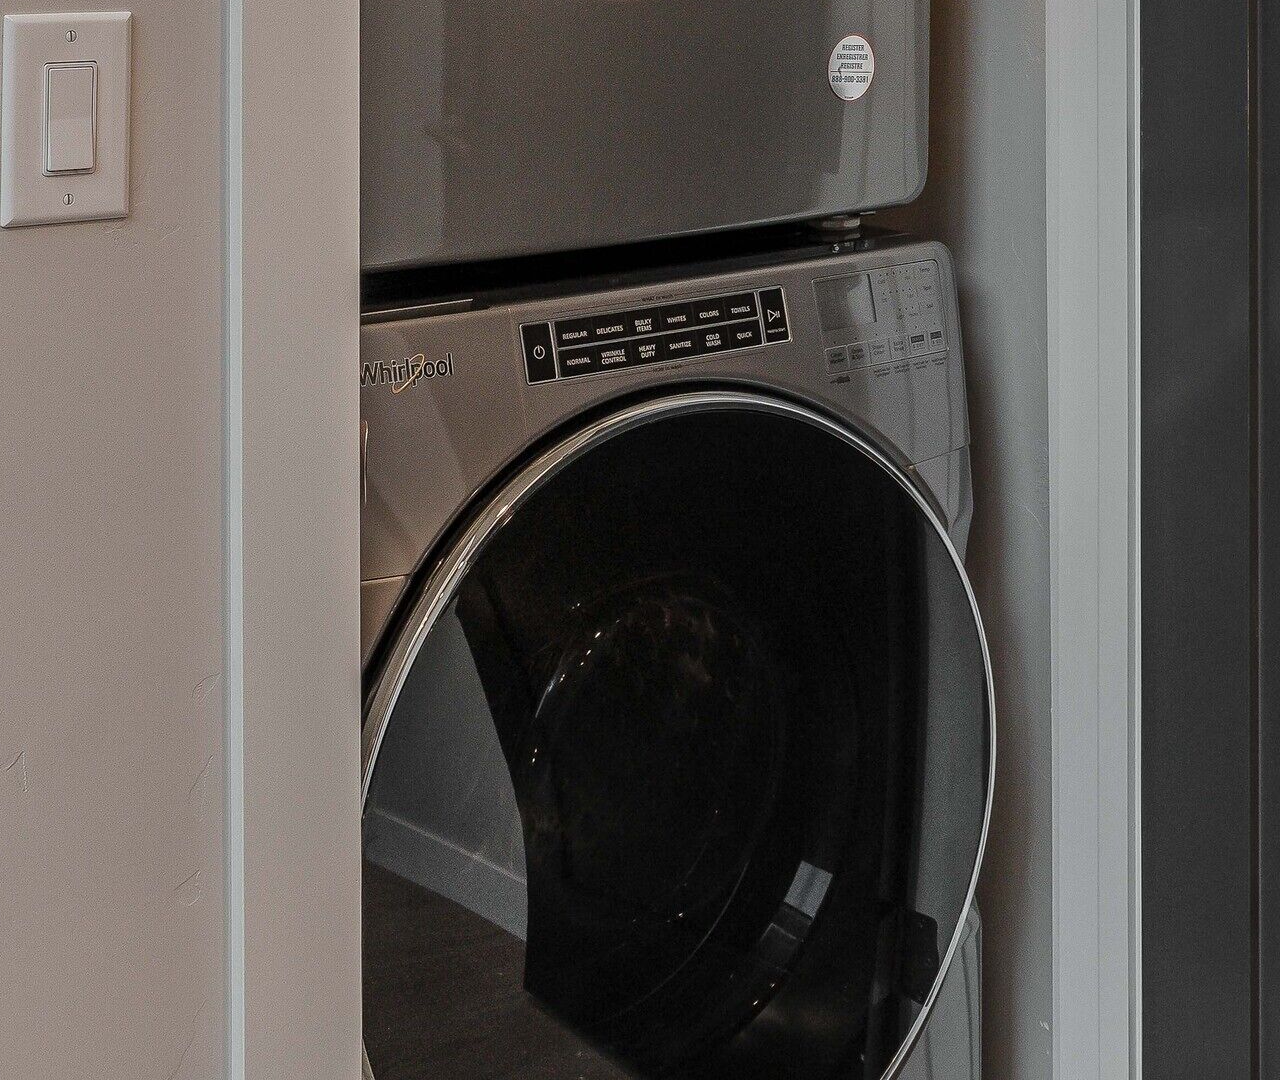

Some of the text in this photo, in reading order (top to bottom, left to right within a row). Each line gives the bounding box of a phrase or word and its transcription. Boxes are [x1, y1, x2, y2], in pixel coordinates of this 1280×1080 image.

[731, 305, 751, 314] TOWELS
[699, 310, 719, 319] COLORS
[634, 318, 652, 327] BULKY
[667, 315, 687, 324] WHITES
[596, 324, 624, 335] DELICATES
[636, 324, 652, 333] ITEMS
[562, 330, 588, 340] REGULAR
[706, 333, 720, 341] COLD
[737, 331, 753, 340] QUICK
[669, 341, 691, 350] SANITIZE
[706, 339, 721, 347] WASH
[601, 348, 625, 358] WRINKLE
[638, 344, 656, 353] HEAVY
[640, 350, 656, 359] DUTY
[566, 357, 591, 366] NORMAL
[601, 355, 627, 365] CONTROL
[360, 352, 454, 389] Whirlpool
